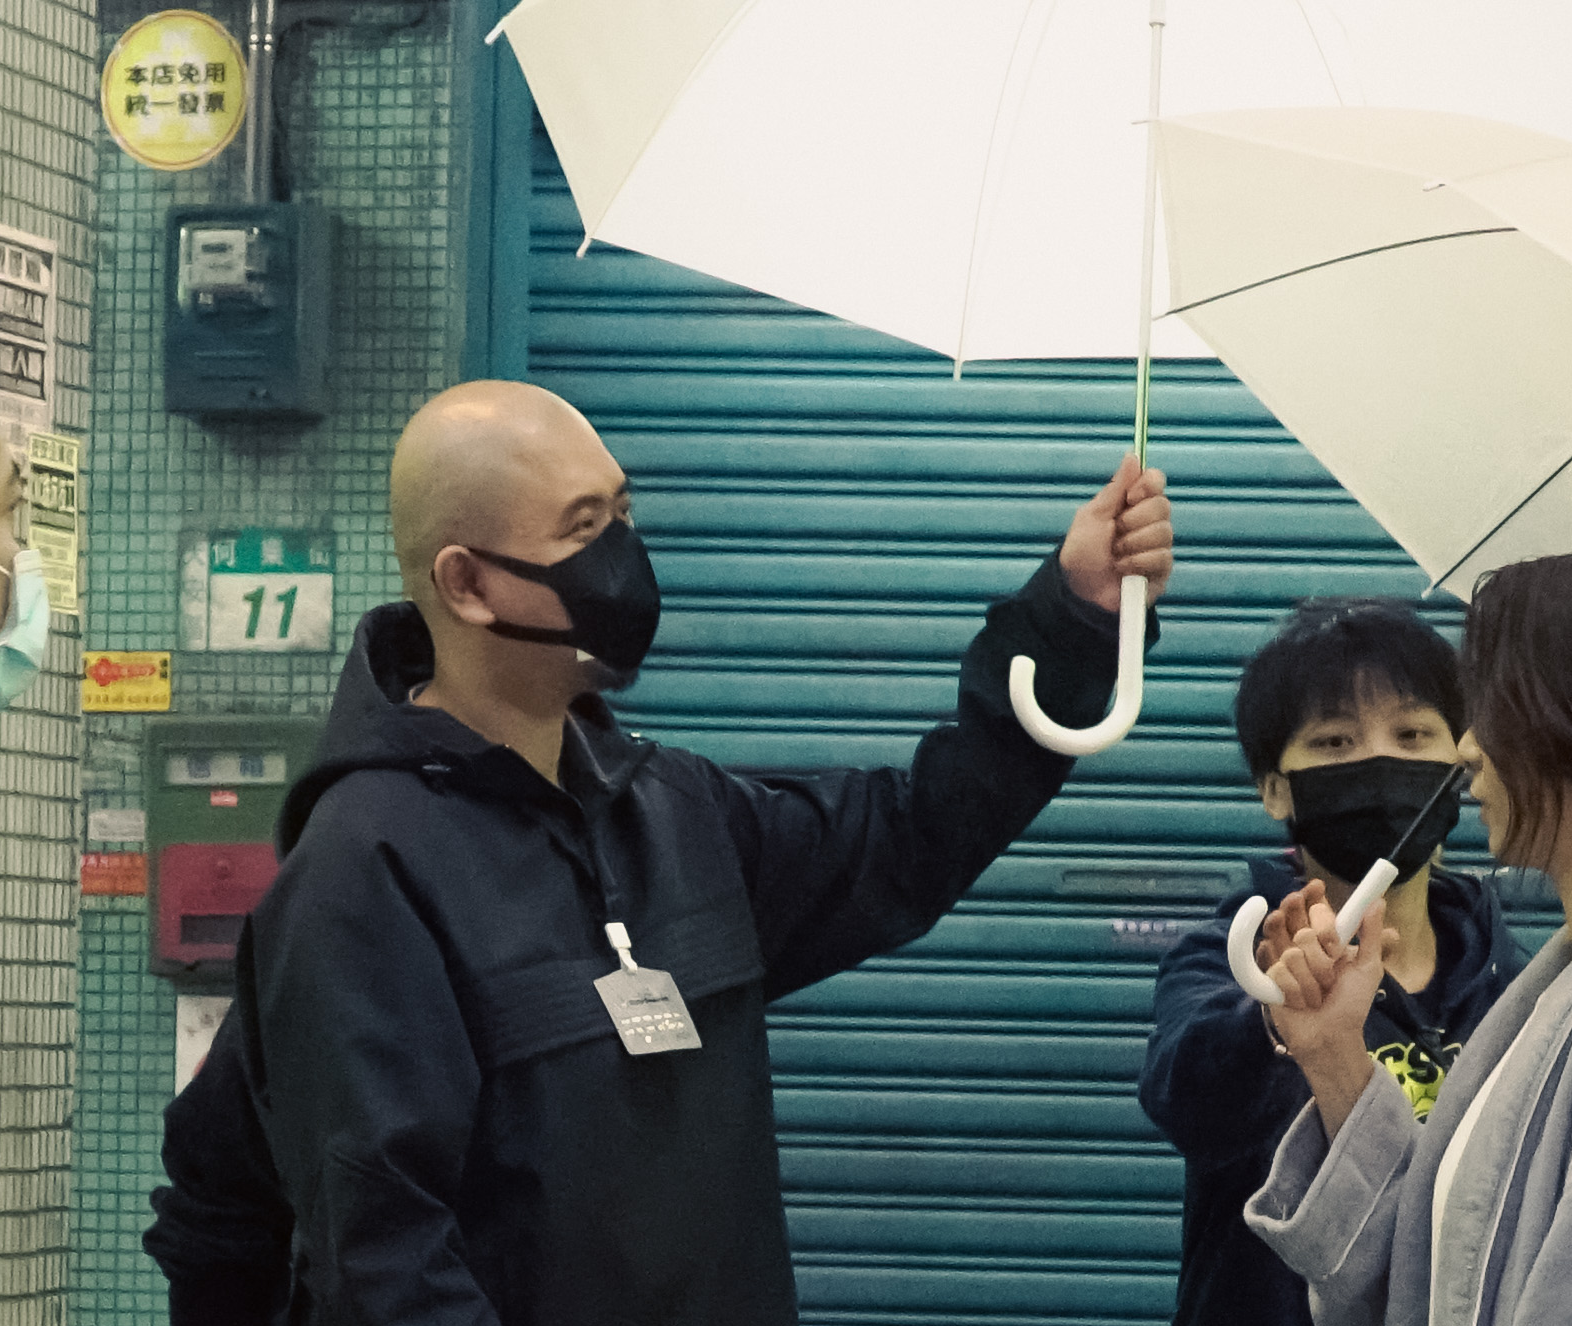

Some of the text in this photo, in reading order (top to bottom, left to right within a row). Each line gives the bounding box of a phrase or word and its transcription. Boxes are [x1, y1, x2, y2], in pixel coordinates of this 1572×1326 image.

[125, 62, 226, 86] 本店免用
[242, 585, 298, 639] 11
